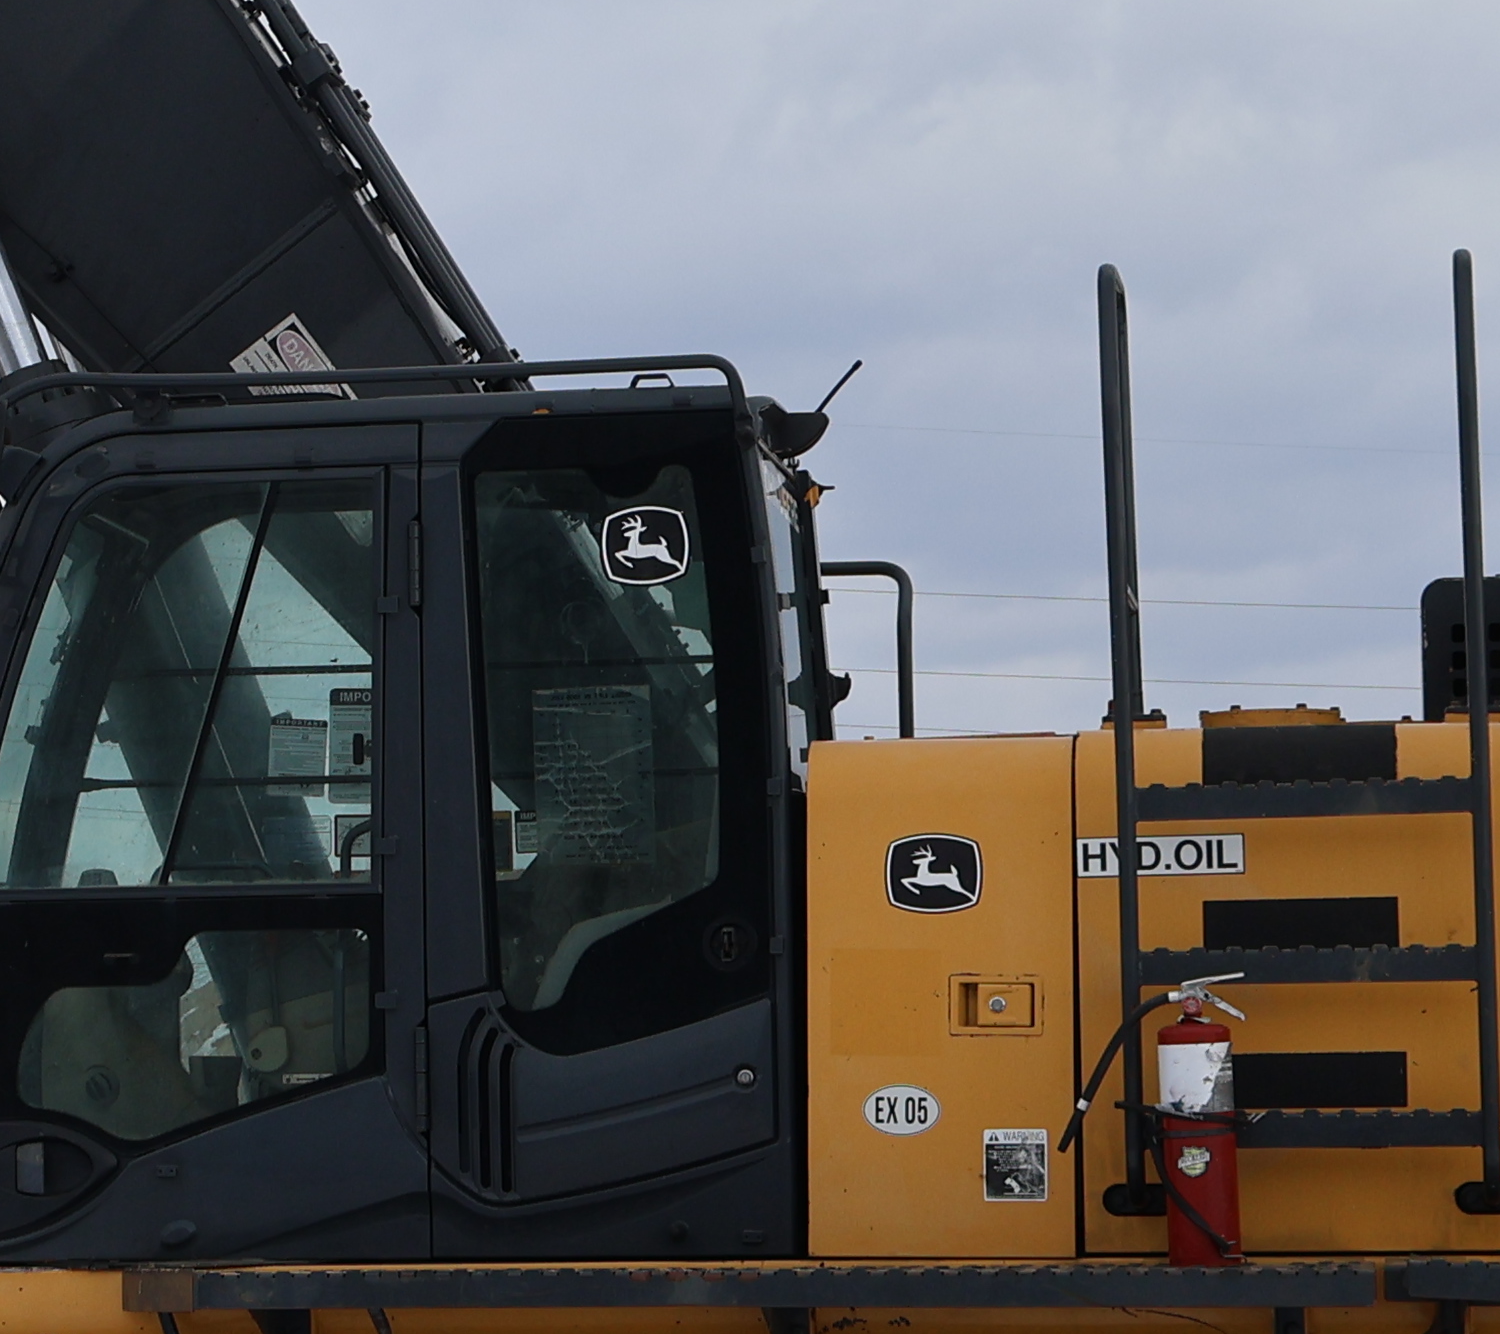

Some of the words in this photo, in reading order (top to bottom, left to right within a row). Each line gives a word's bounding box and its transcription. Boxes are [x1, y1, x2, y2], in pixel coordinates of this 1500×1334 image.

[340, 691, 372, 702] IMPO
[874, 1095, 899, 1126] EX
[902, 1095, 929, 1126] 05
[1002, 1131, 1045, 1142] WARNING
